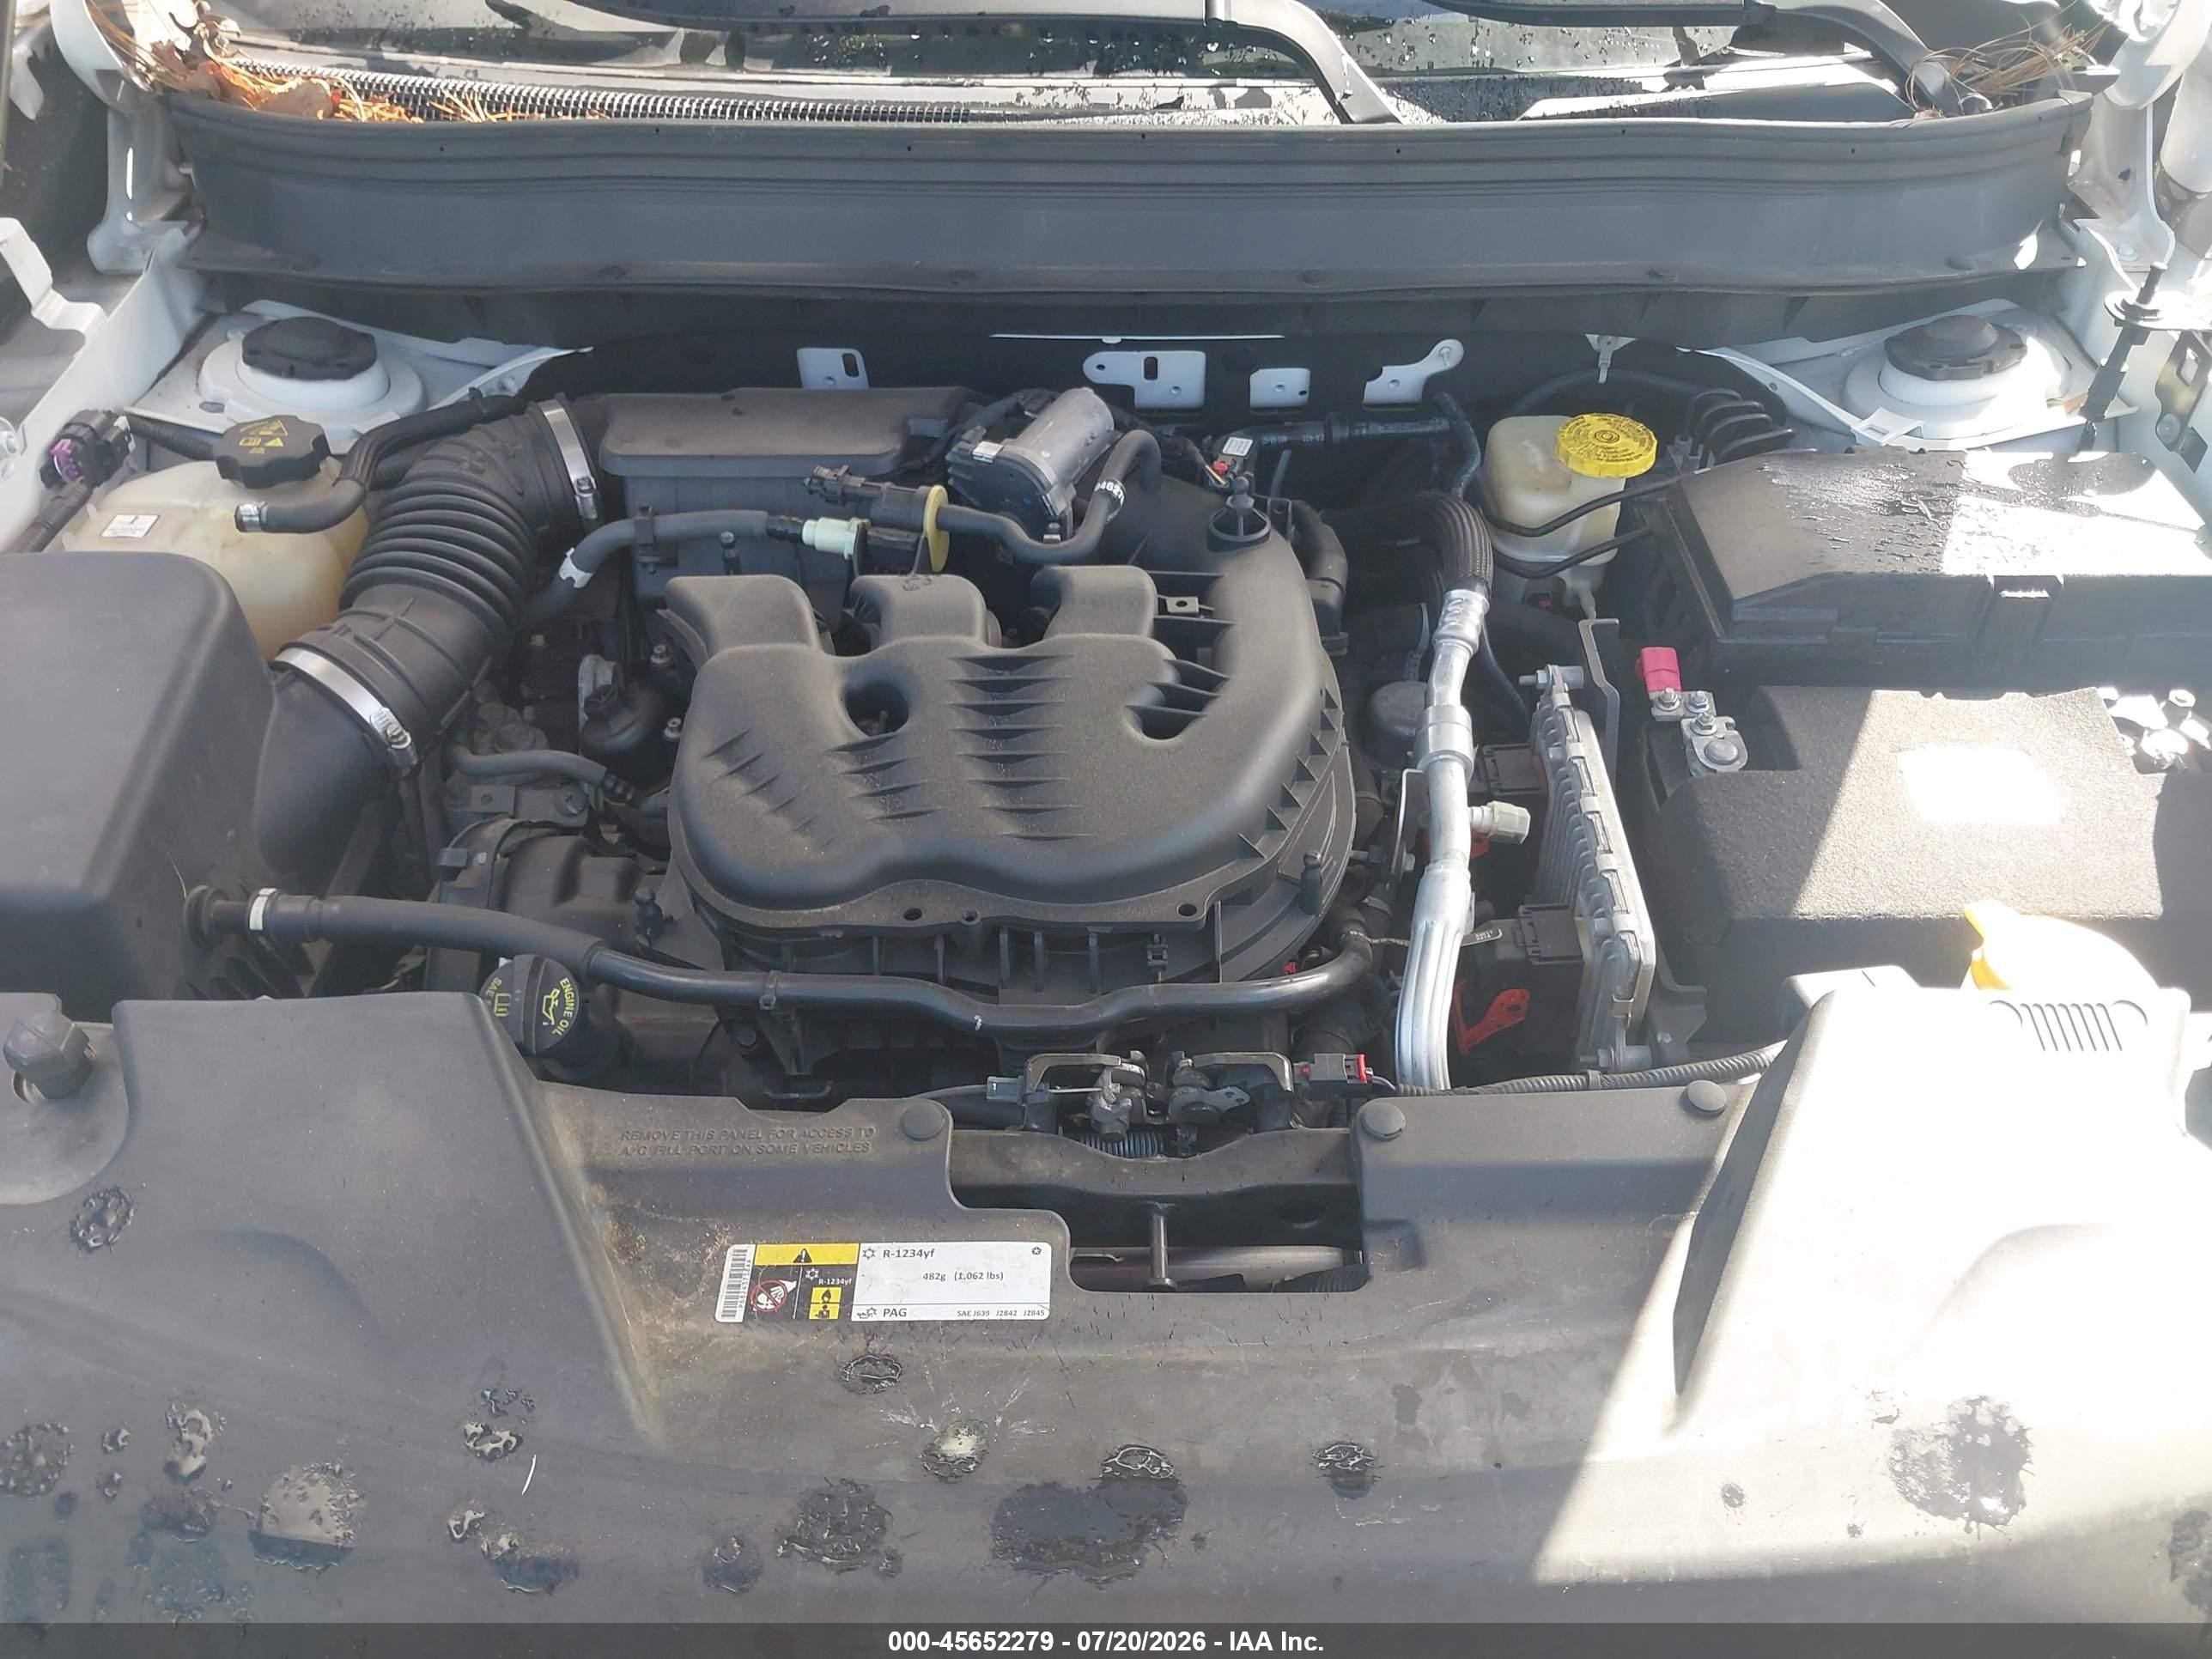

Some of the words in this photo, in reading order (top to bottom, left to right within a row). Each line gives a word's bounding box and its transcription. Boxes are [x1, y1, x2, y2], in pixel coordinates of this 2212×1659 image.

[559, 977, 574, 1018] ENGINE
[552, 1019, 569, 1036] OIL
[621, 1130, 680, 1141] REMOVE
[686, 1129, 715, 1140] THIS
[720, 1129, 763, 1140] PANEL
[769, 1128, 797, 1139] FOR
[799, 1127, 853, 1139] ACCESS
[859, 1127, 877, 1139] TO
[656, 1145, 682, 1155] FILL
[690, 1145, 726, 1155] PORT
[732, 1144, 751, 1155] ON
[756, 1144, 798, 1154] SOME
[804, 1142, 871, 1153] VEHICLES
[882, 1248, 935, 1260] R-1234yf
[922, 1273, 946, 1281] 482g
[987, 1271, 1004, 1281] lbs)
[882, 1308, 907, 1317] PAG
